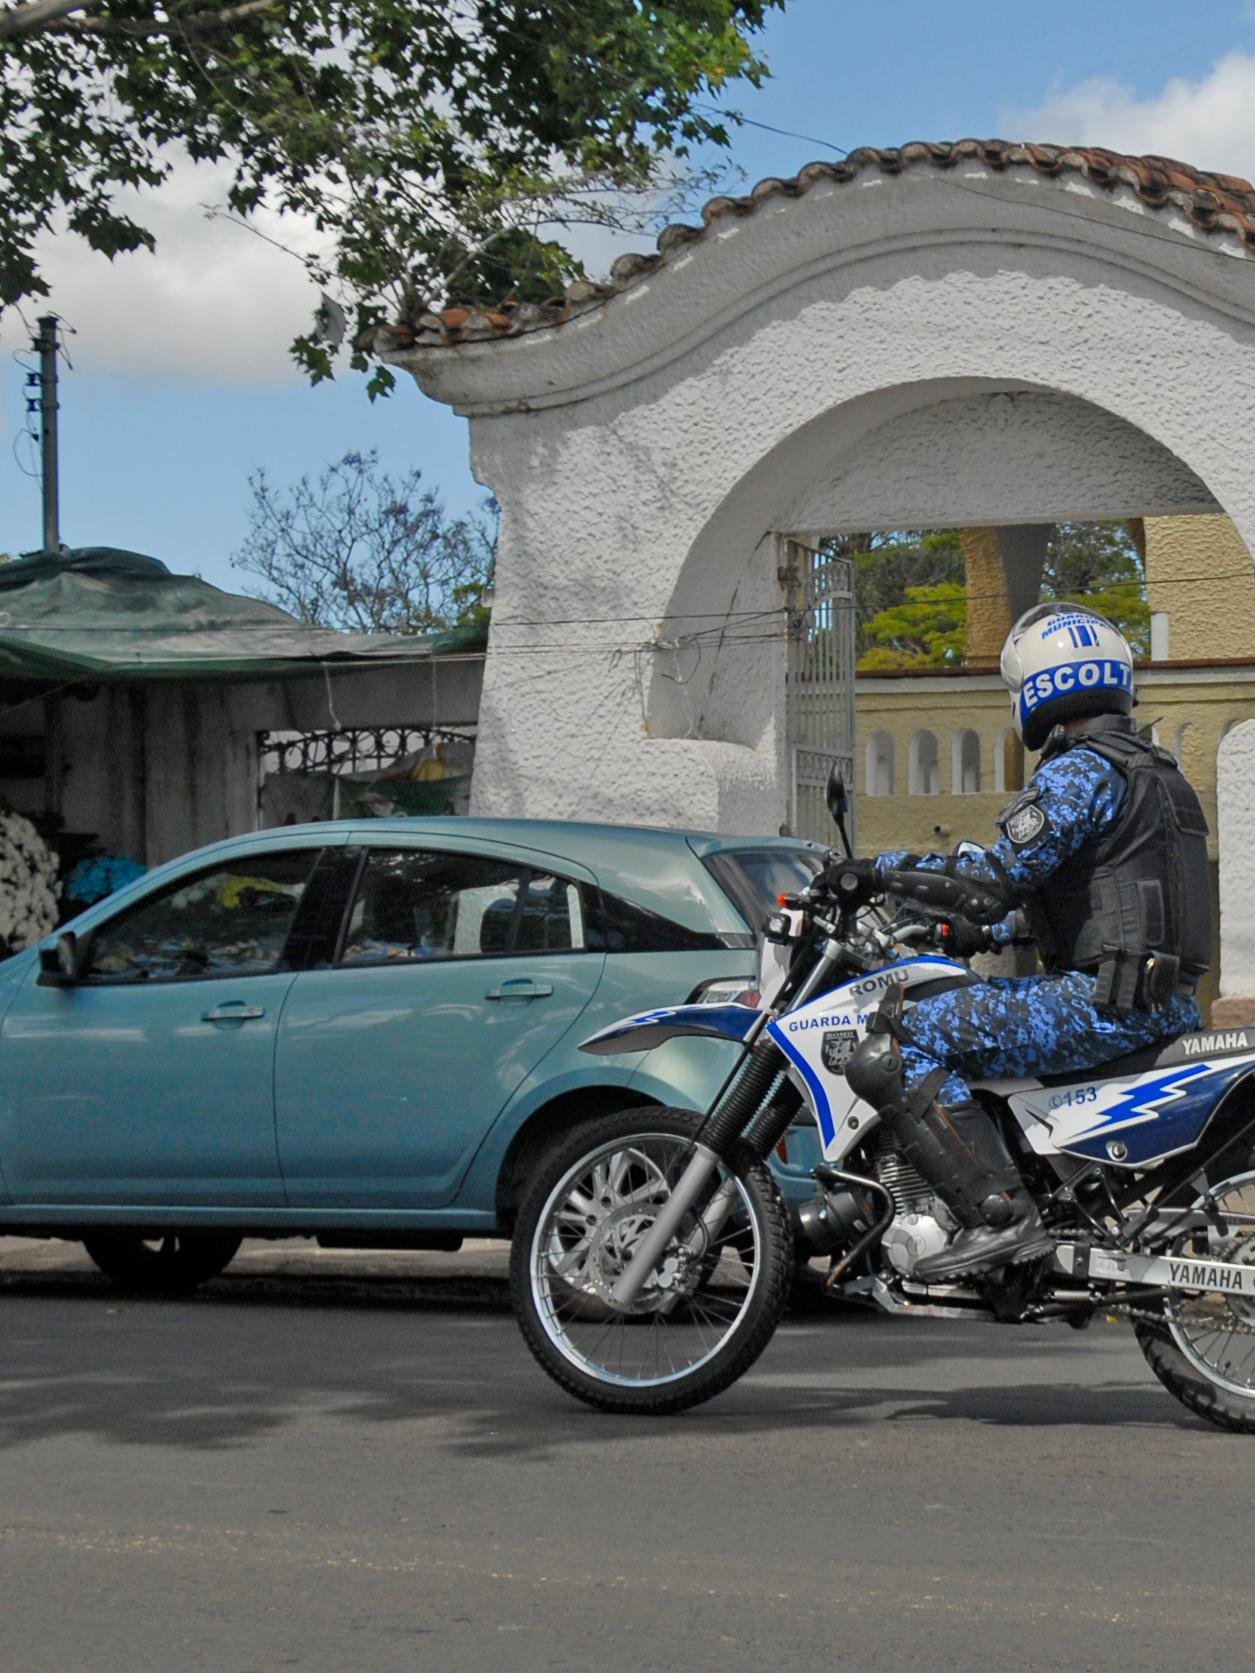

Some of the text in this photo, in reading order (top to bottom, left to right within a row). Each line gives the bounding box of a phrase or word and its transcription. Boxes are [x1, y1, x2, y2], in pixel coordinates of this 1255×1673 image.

[1023, 662, 1133, 708] ESCOLT
[849, 969, 909, 996] ROMU
[789, 1015, 851, 1032] GUARDA
[1182, 1032, 1248, 1055] YAMAHA
[1169, 1263, 1243, 1290] YAMAHA
